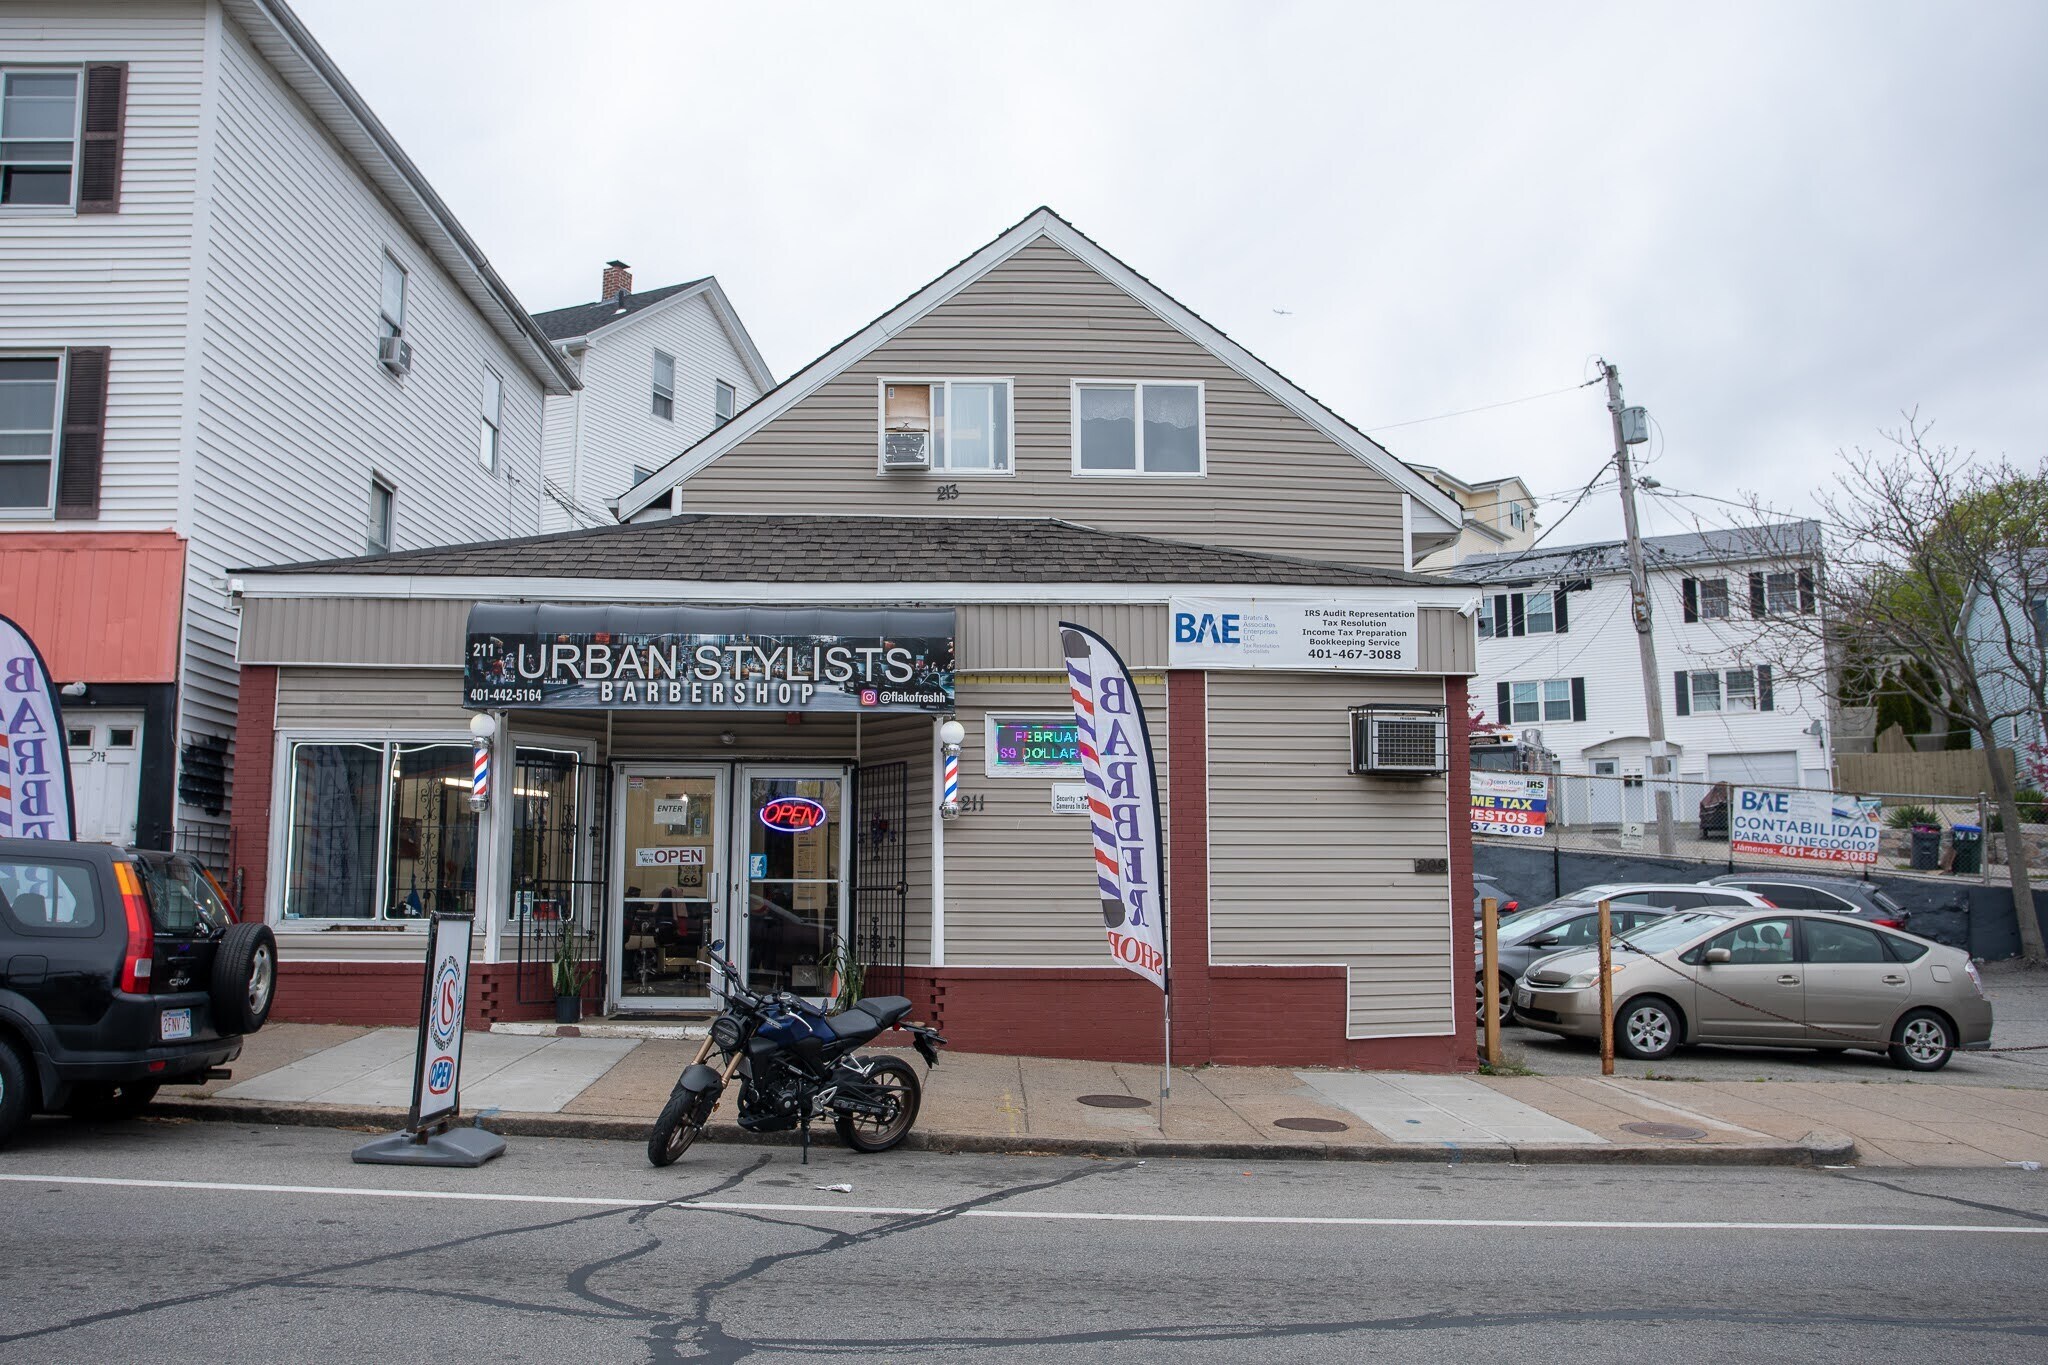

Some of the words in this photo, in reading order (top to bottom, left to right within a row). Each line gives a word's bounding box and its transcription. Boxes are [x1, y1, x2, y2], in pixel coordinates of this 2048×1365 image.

[937, 484, 959, 501] 213
[1323, 609, 1346, 617] Audit
[1348, 610, 1415, 619] Representation
[1176, 613, 1240, 643] BAE
[1322, 619, 1338, 627] Tax
[1243, 628, 1278, 636] Enterprises
[1302, 628, 1335, 636] Income
[1338, 629, 1353, 637] Tax
[1356, 630, 1407, 638] Preparation
[1309, 638, 1366, 647] Bookkeeping
[1368, 639, 1400, 647] Service
[473, 643, 494, 657] 211
[1308, 649, 1402, 660] 401-467-3088
[518, 643, 677, 680] URBAN
[694, 645, 913, 683] STYLISTS
[470, 688, 542, 702] 401-442-5164
[601, 681, 814, 704] BARBERSHOP
[880, 690, 946, 704] @flakofreshh
[1526, 780, 1544, 789] IRS
[961, 794, 984, 812] 211
[1056, 795, 1076, 803] Security
[1056, 802, 1075, 810] Cameras
[1500, 797, 1532, 811] TAX
[1741, 791, 1789, 813] BAE
[657, 805, 683, 813] ENTER
[764, 803, 820, 827] OPEN
[1471, 821, 1543, 835] 67-3088
[1734, 816, 1877, 839] CONTABILIDAD
[1734, 831, 1770, 843] PARA
[1775, 835, 1794, 845] SU
[1798, 837, 1876, 852] NEGOCIO?
[654, 849, 703, 863] OPEN
[1779, 846, 1876, 862] 401-467-3088
[430, 1062, 453, 1089] OPEN
